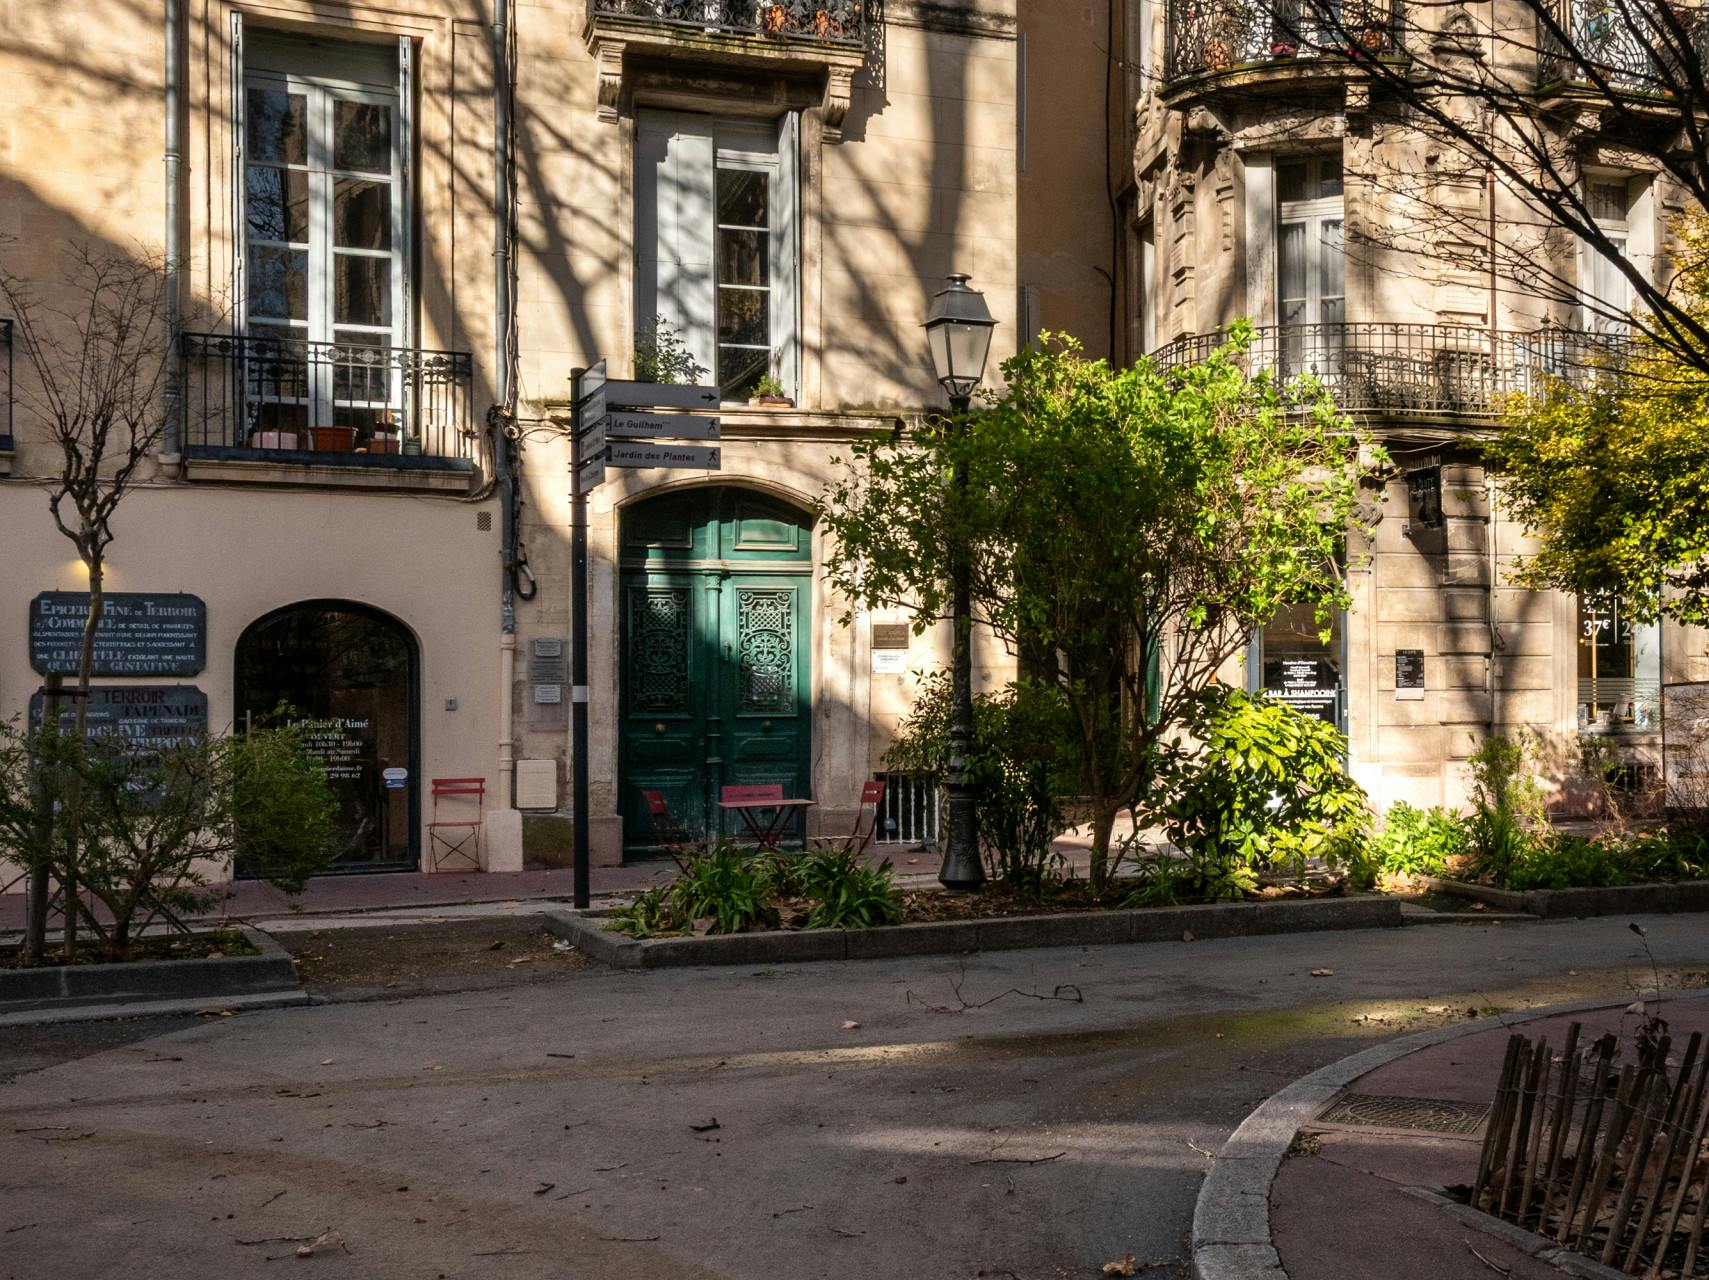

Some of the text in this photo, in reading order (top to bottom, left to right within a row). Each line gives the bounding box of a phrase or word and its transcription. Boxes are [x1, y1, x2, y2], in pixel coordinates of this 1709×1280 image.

[614, 420, 664, 430] Le Guilhem
[614, 450, 696, 462] Jardin des Plantes
[1583, 620, 1611, 637] 37€
[103, 689, 165, 705] TERROIR
[334, 718, 369, 729] d'Aimé
